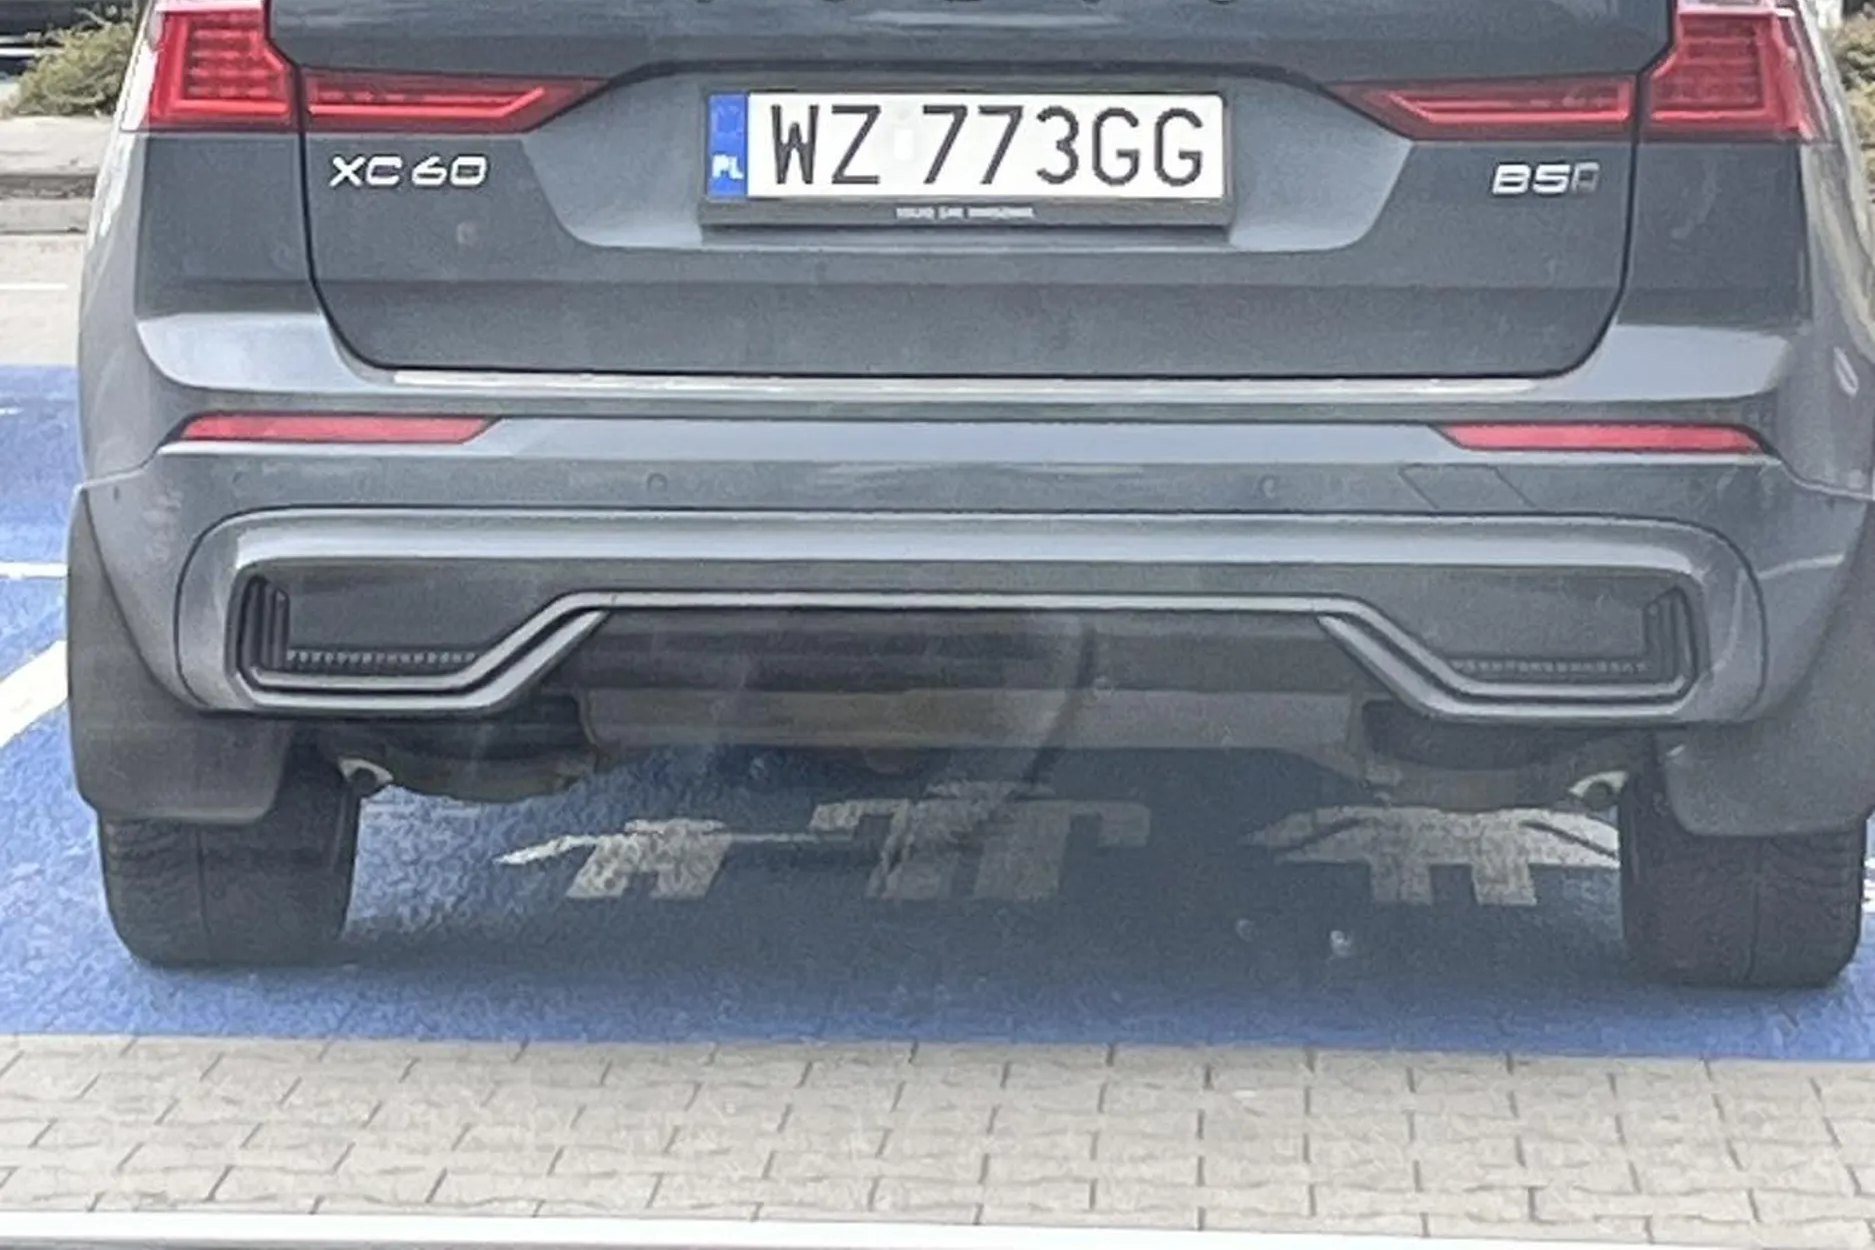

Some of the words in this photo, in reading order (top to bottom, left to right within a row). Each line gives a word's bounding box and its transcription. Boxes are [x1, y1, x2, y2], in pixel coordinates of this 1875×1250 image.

[712, 153, 744, 179] PL
[770, 104, 881, 185] WZ
[922, 104, 1203, 186] 773GG
